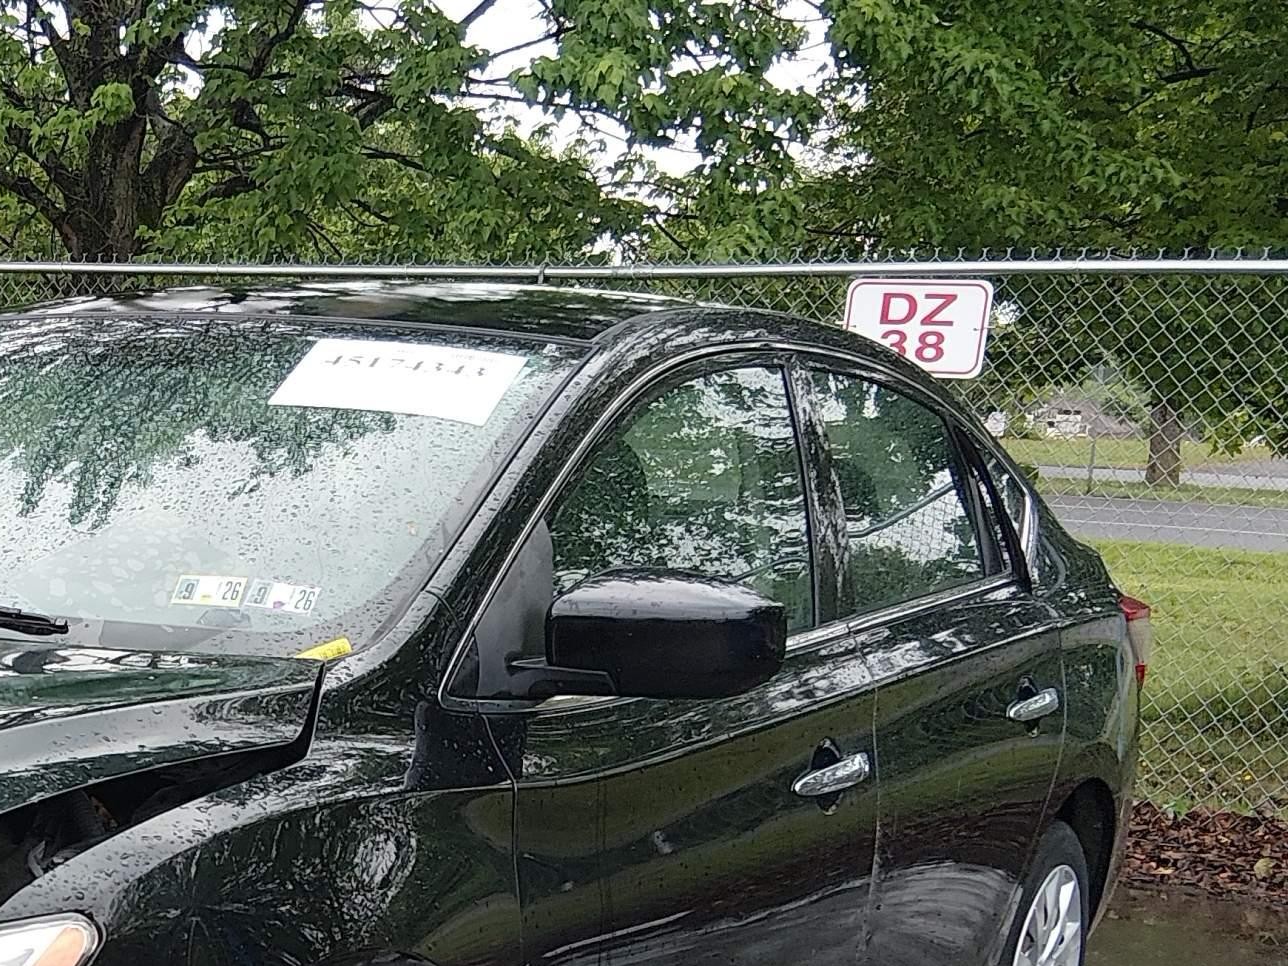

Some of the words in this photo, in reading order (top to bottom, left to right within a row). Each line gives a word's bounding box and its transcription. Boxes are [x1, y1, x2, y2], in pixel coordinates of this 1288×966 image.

[879, 292, 958, 326] DZ
[880, 329, 946, 363] 38
[222, 580, 242, 601] 26
[294, 589, 316, 611] 26
